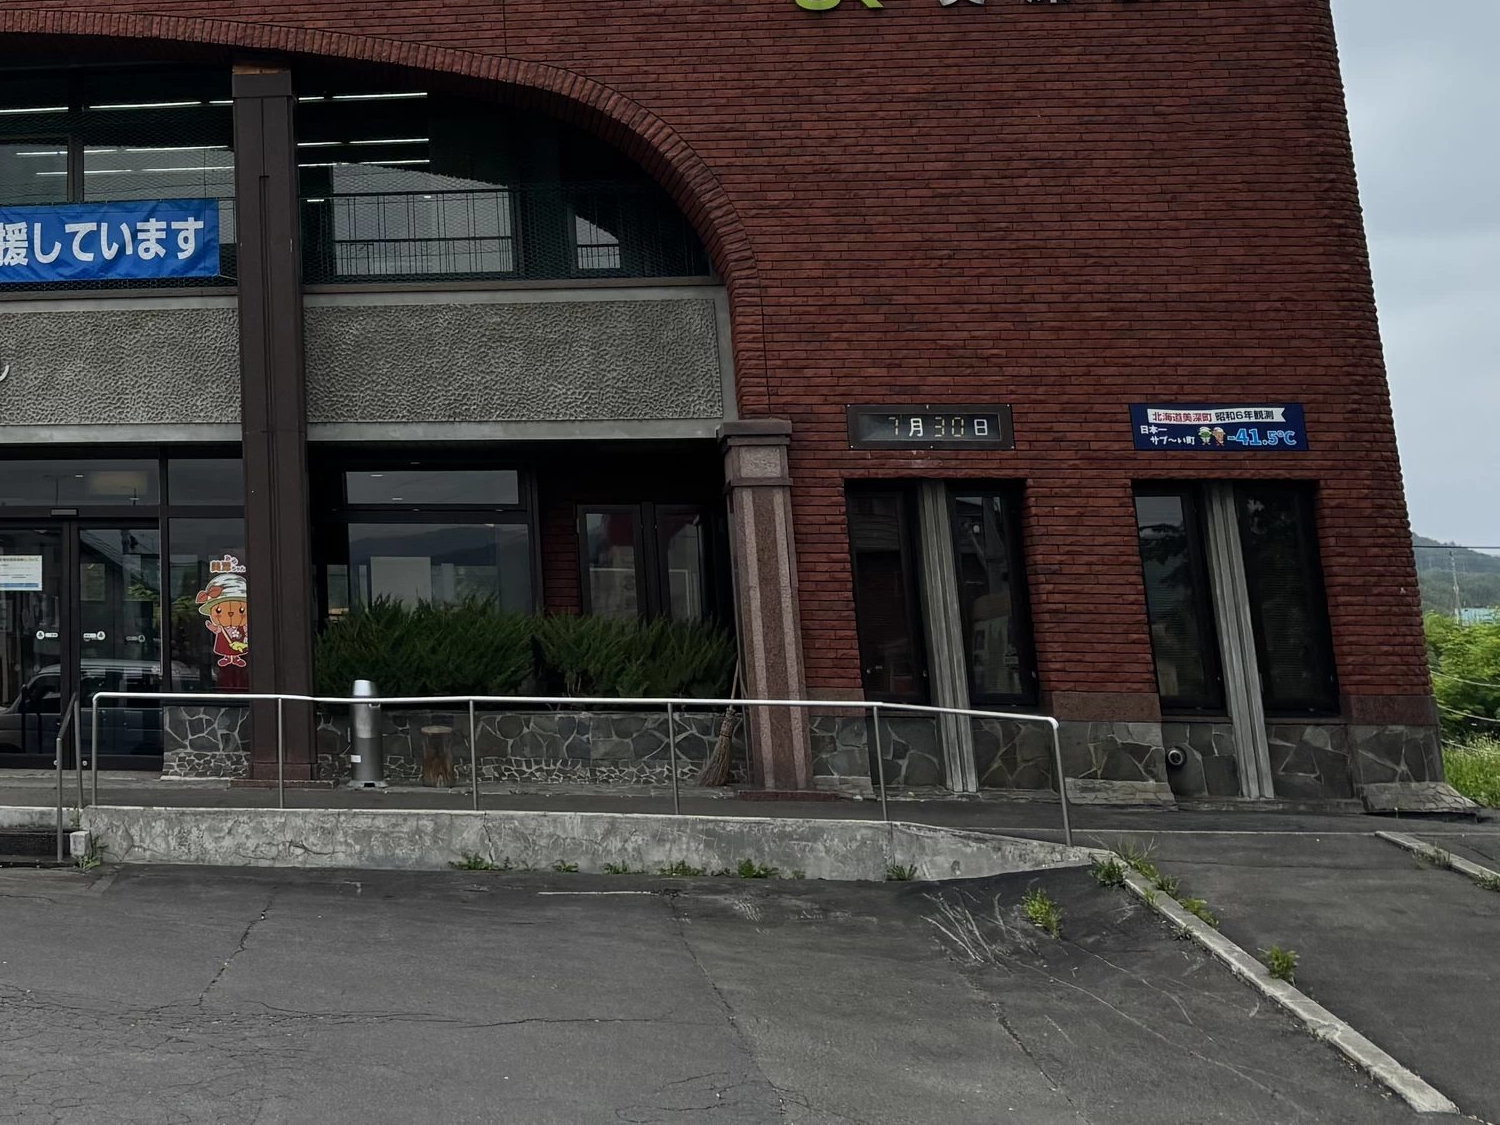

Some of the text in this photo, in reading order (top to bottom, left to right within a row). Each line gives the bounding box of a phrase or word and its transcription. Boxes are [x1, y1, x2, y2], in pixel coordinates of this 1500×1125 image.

[1152, 410, 1275, 422] 北海道美深町 昭和6年観測
[1140, 425, 1167, 435] 日本一
